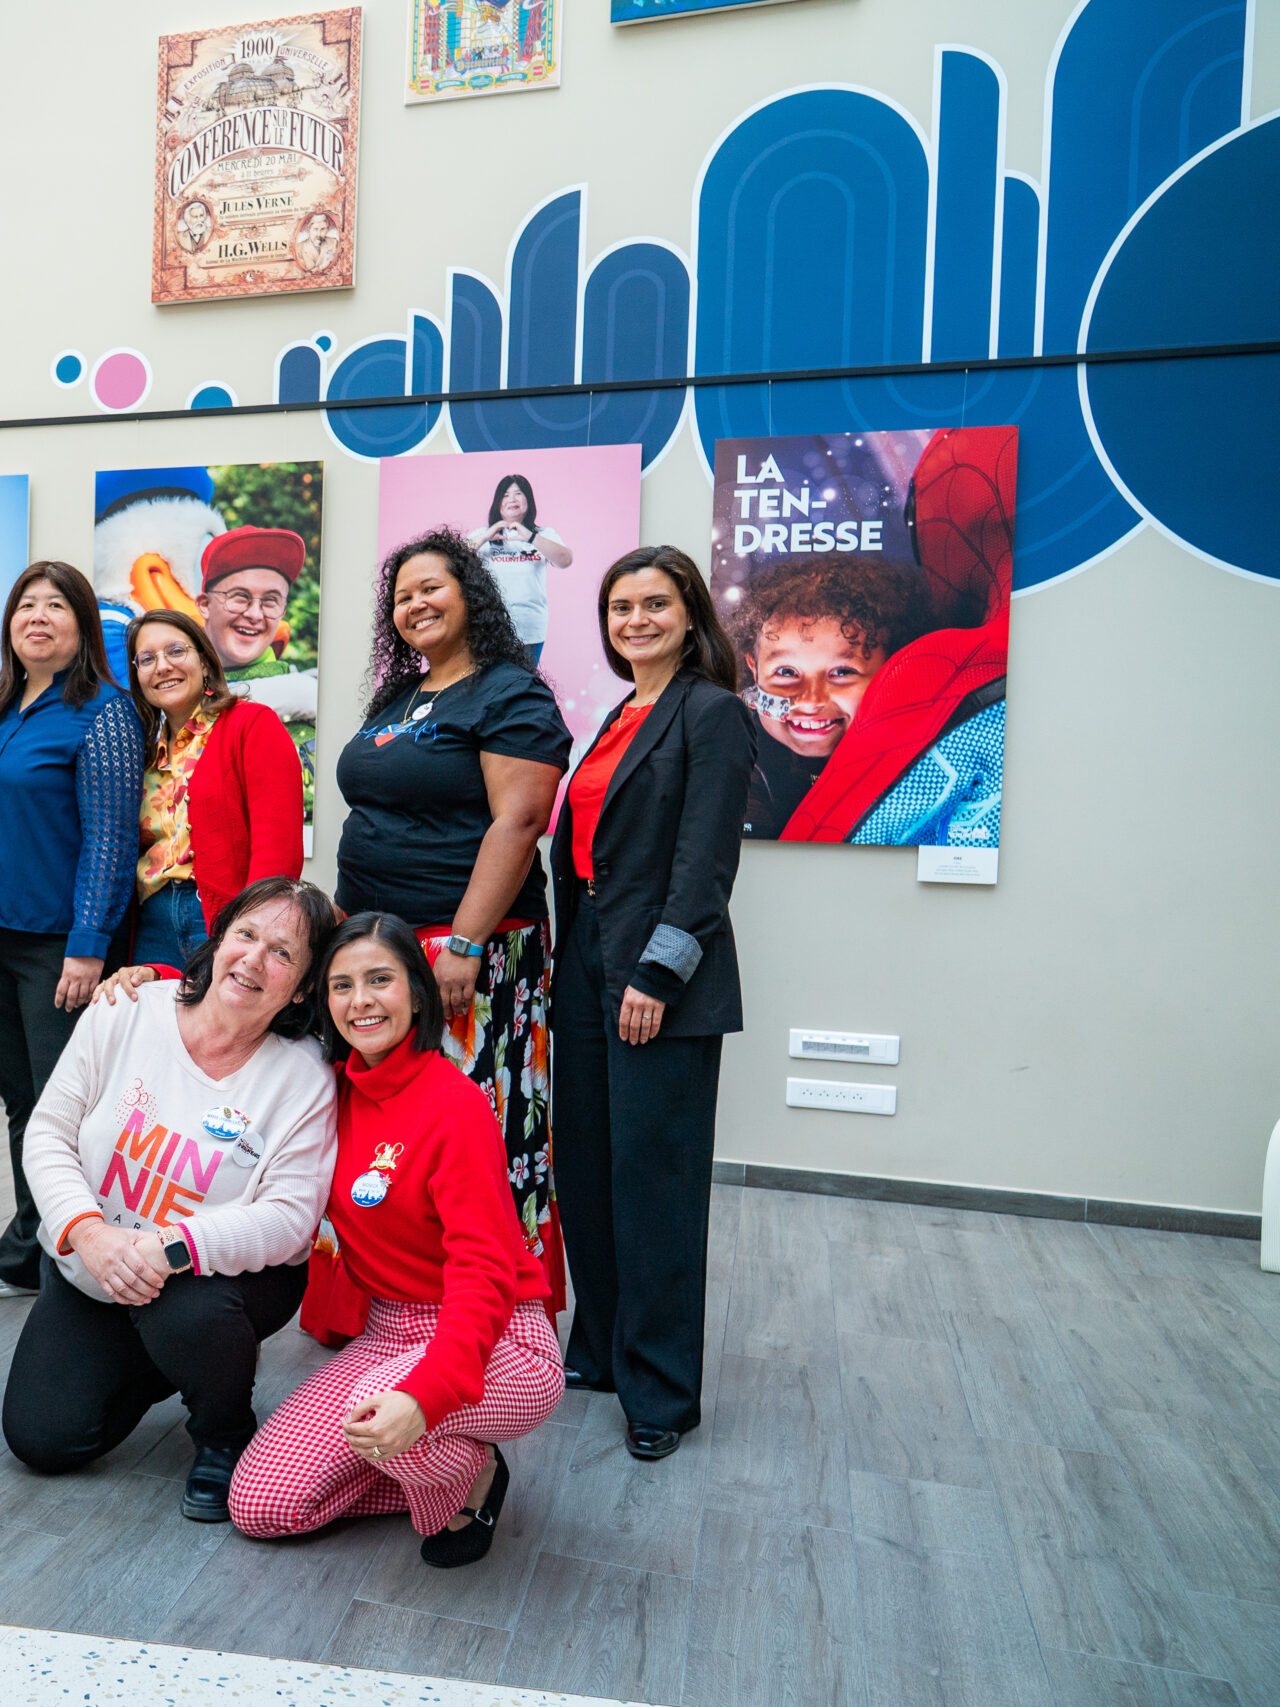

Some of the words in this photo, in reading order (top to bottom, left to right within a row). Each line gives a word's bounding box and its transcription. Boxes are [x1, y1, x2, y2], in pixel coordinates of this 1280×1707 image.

[241, 36, 274, 59] 1900
[279, 46, 329, 70] UNIVERSELLE
[184, 57, 226, 91] EXPOSITION
[272, 109, 288, 127] SUR
[274, 127, 285, 145] LE
[289, 111, 344, 173] FUTUR
[217, 156, 262, 172] MERCREDI
[265, 156, 276, 166] 20
[278, 153, 297, 164] MAI
[219, 201, 254, 215] JULES
[255, 196, 295, 210] VERNE
[736, 453, 785, 484] LA
[734, 487, 827, 518] TEN-
[734, 521, 883, 553] DRESSE
[115, 1108, 224, 1195] MIN
[99, 1150, 205, 1229] NIE
